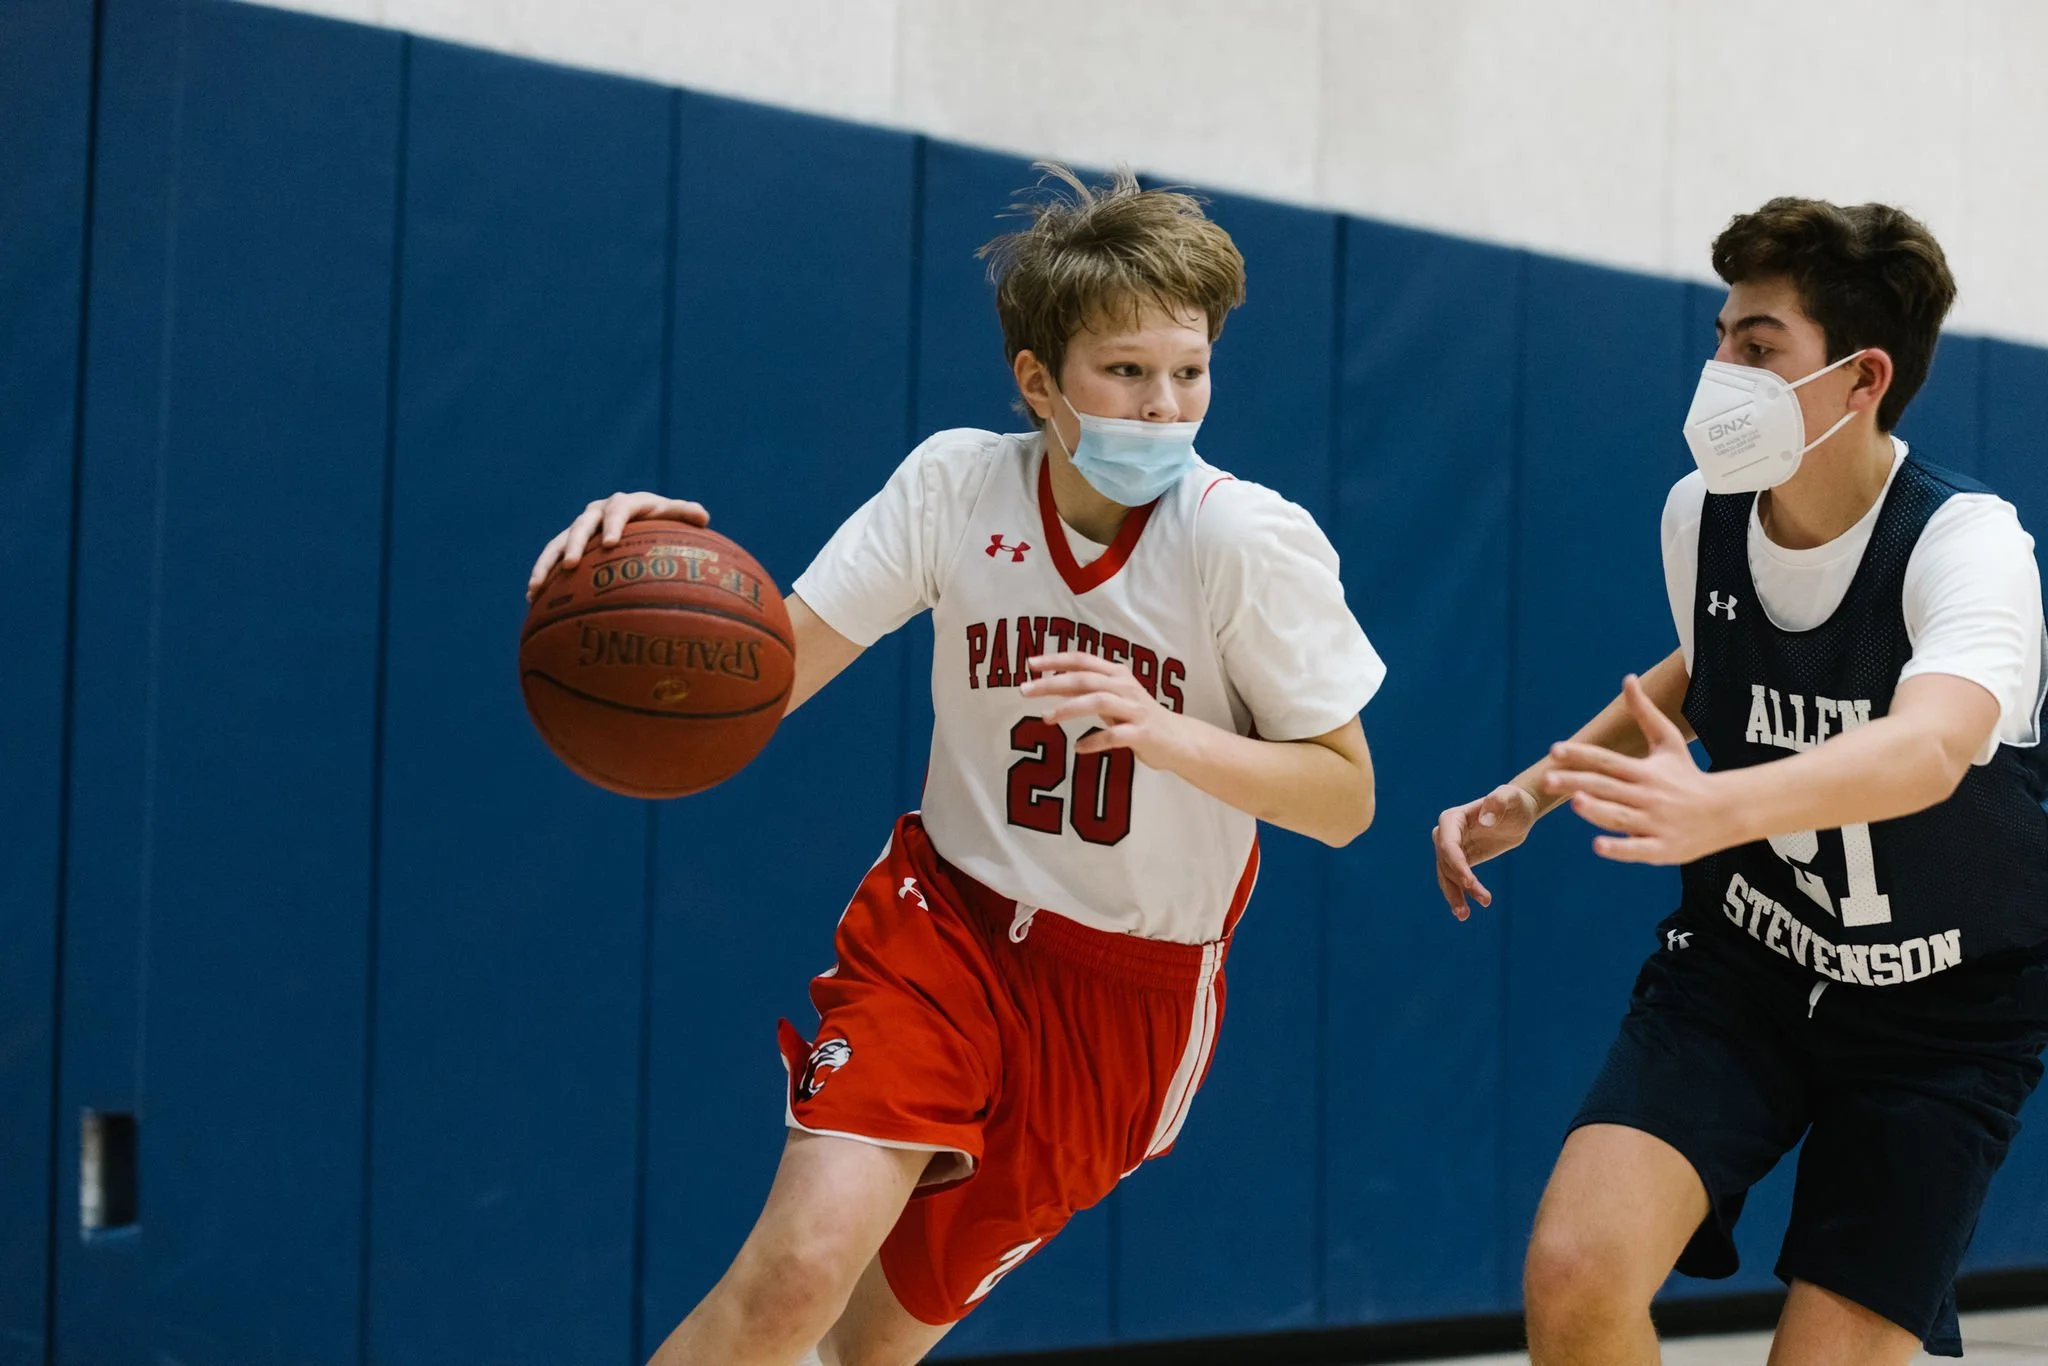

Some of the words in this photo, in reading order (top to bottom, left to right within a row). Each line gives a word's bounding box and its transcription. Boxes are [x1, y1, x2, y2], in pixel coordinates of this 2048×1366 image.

[1708, 414, 1753, 442] BNX
[577, 624, 761, 681] SPALDING
[1006, 715, 1135, 847] 20
[1722, 872, 1963, 987] STEVENSON
